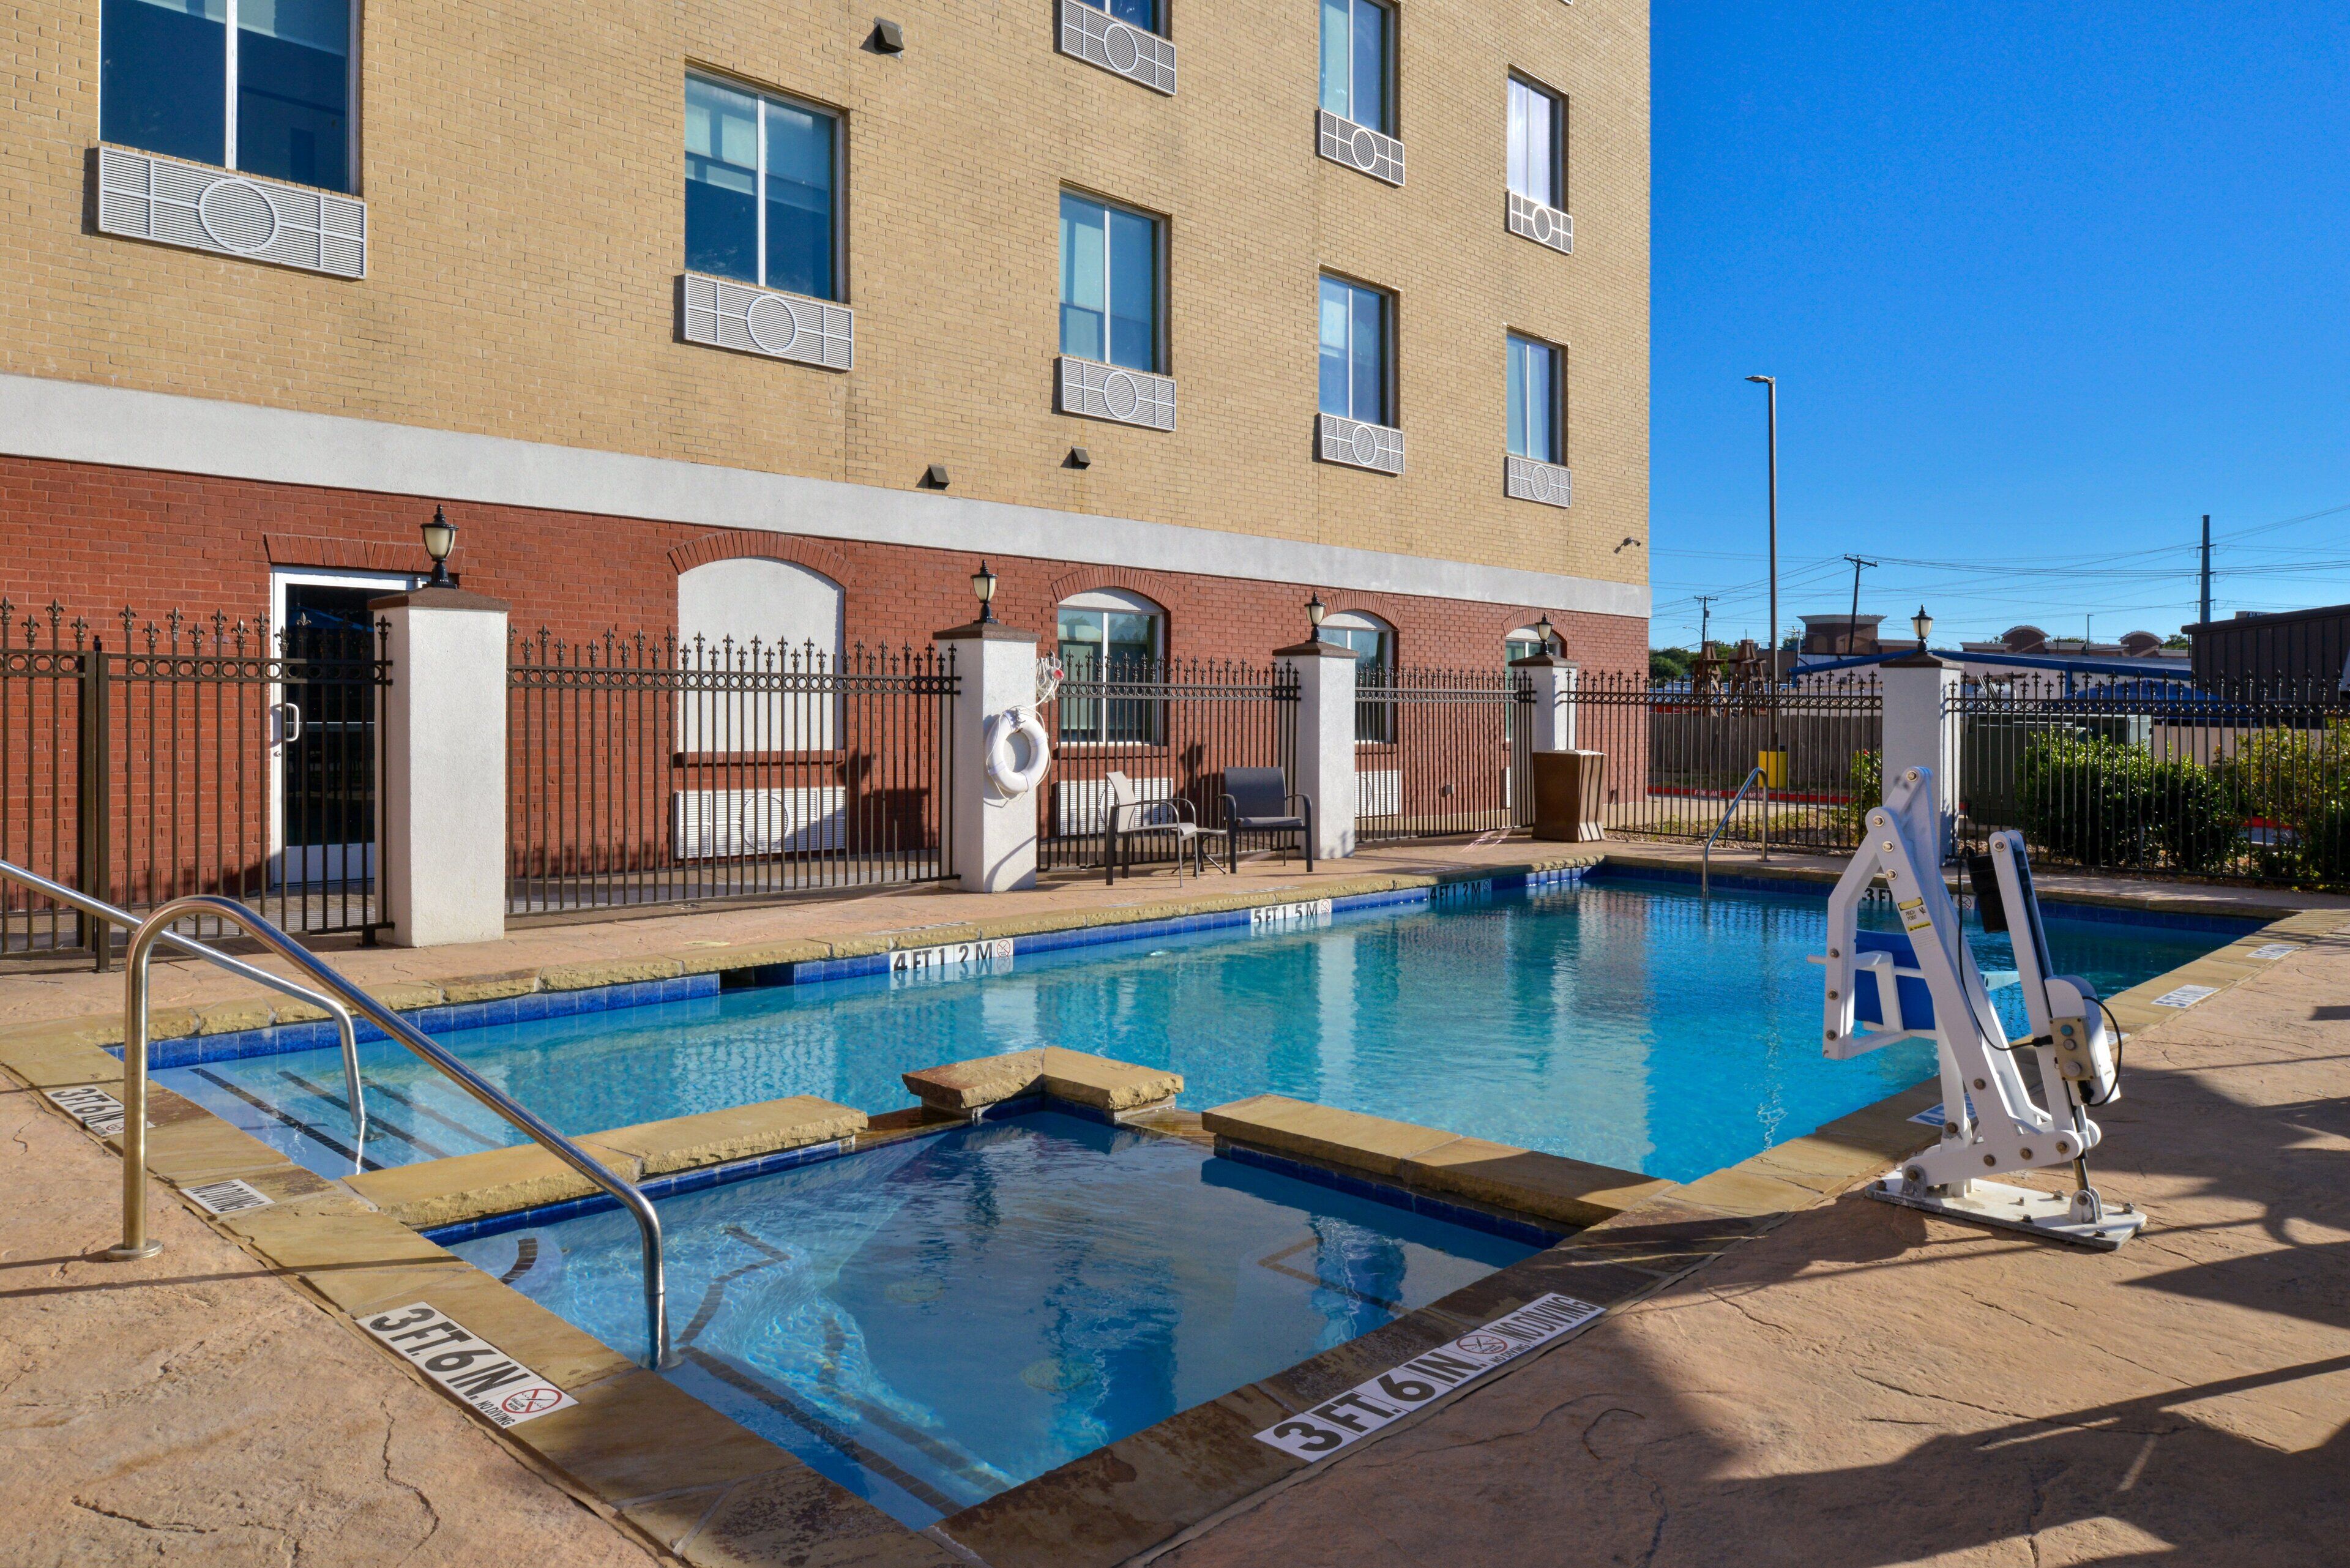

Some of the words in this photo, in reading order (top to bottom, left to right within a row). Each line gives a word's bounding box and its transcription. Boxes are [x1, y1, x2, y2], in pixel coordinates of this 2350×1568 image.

[975, 942, 993, 960] M
[51, 1088, 97, 1097] 3
[73, 1105, 121, 1114] 6
[187, 1181, 239, 1193] NO
[198, 1188, 265, 1212] DIVING
[1510, 1297, 1598, 1332] DIVING
[369, 1308, 436, 1331] 3
[425, 1348, 498, 1372] 6
[1489, 1322, 1545, 1343] NO
[1503, 1343, 1530, 1362] DIVING
[476, 1400, 492, 1410] NO
[487, 1406, 515, 1425] DIVING
[1273, 1421, 1343, 1452] 3
[1377, 1374, 1436, 1402] 6
